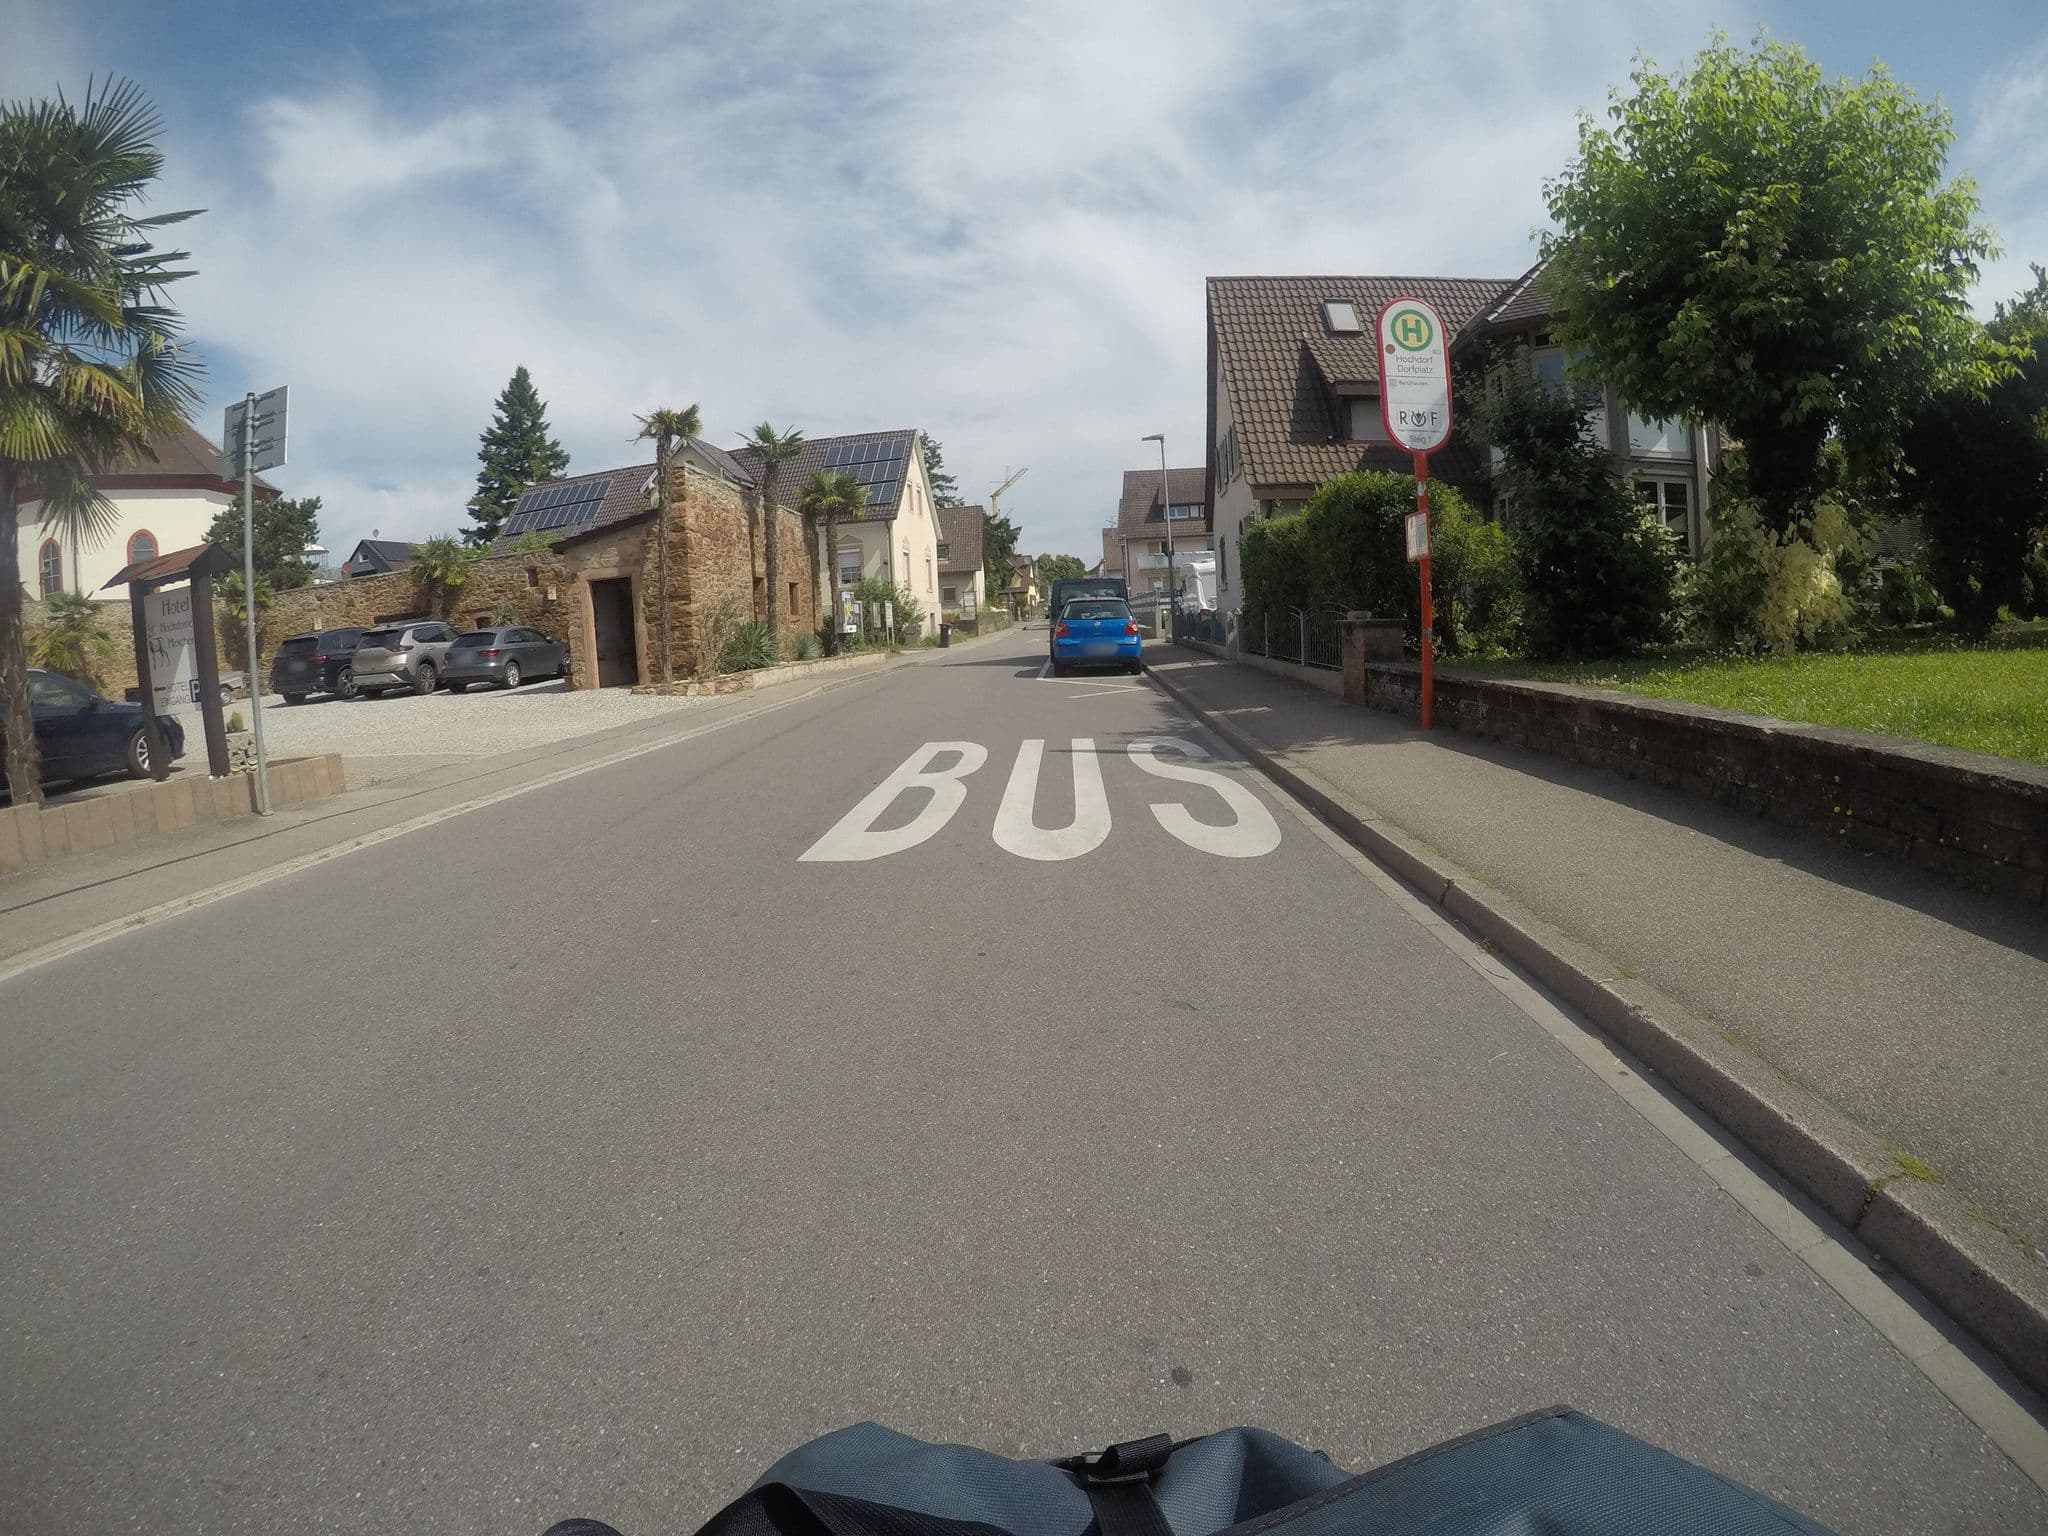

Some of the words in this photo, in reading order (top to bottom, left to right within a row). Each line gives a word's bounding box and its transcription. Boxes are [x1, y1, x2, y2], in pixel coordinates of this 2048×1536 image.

[1401, 318, 1423, 343] H
[1395, 355, 1433, 364] Hochdorf
[1397, 364, 1433, 374] Dorfplatz
[161, 596, 191, 616] Hotel
[166, 681, 191, 694] HOTEL
[796, 737, 1282, 862] BUS
